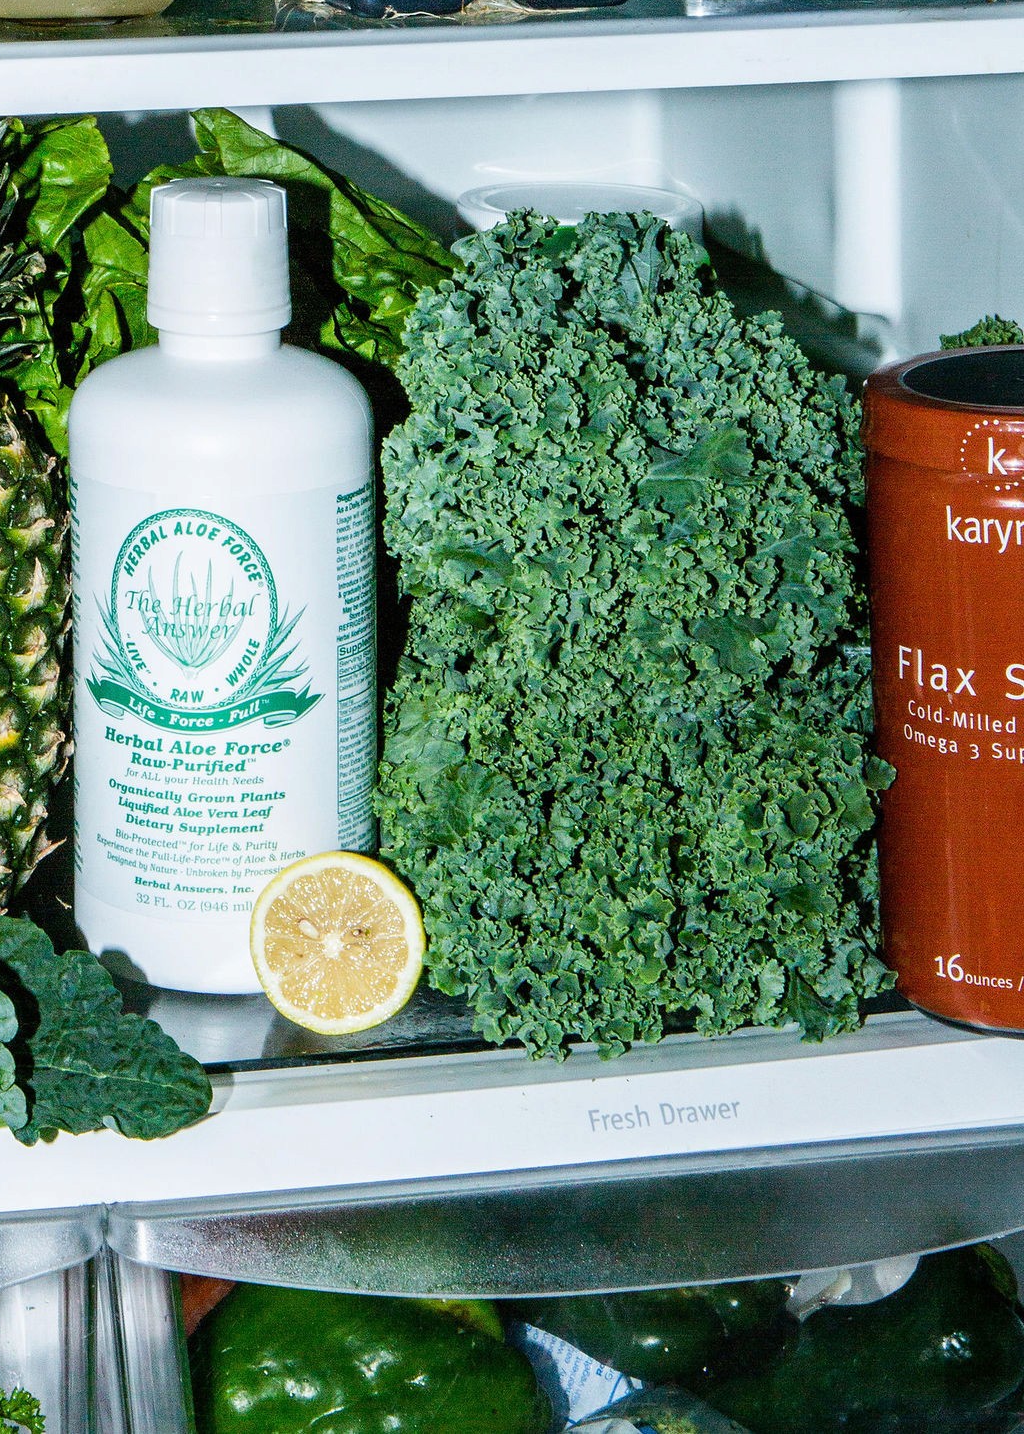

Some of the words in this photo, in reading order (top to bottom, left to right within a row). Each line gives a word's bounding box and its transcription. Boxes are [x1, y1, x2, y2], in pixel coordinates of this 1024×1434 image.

[124, 526, 168, 577] HERBAL
[174, 522, 221, 541] ALOE
[125, 590, 161, 614] The
[170, 592, 261, 617] Herbal
[141, 616, 235, 640] Answer
[170, 689, 204, 703] RAW
[225, 638, 260, 687] WHOLE
[899, 645, 976, 696] Flax
[128, 697, 156, 719] Life
[169, 713, 214, 728] Force
[908, 700, 1016, 734] Cold-Milled
[105, 726, 163, 752] Herbal
[169, 740, 216, 755] Aloe
[904, 724, 958, 754] Omega
[969, 744, 980, 760] 3
[125, 768, 139, 778] for
[140, 771, 161, 782] ALL
[164, 776, 188, 785] your
[192, 775, 229, 785] Health
[232, 775, 264, 785] Needs
[109, 778, 182, 804] Organically
[187, 792, 235, 803] Grown
[240, 790, 286, 803] Plants
[118, 796, 169, 816] Liquified
[173, 807, 203, 818] Aloe
[207, 808, 238, 818] Vera
[243, 805, 274, 819] Leaf
[125, 813, 173, 832] Dietary
[179, 822, 264, 836] Supplement
[96, 833, 133, 854] Experience
[135, 847, 149, 857] the
[232, 855, 242, 866] of
[244, 854, 266, 864] Aloe
[269, 853, 276, 862] &
[280, 849, 306, 861] Herbs
[188, 841, 204, 853] for
[208, 841, 229, 853] Life
[232, 842, 241, 851] &
[245, 840, 278, 852] Purity
[107, 851, 137, 868] Designed
[138, 860, 148, 872] by
[150, 863, 177, 875] Nature
[186, 867, 228, 877] Unbroken
[231, 868, 242, 879] by
[134, 876, 170, 891] Herbal
[232, 885, 255, 894] Inc.
[136, 892, 150, 905] 32
[154, 896, 172, 908] FL.
[177, 900, 196, 911] OZ
[200, 900, 229, 912] (946
[233, 900, 253, 912] ml)
[588, 1104, 650, 1132] Fresh
[659, 1100, 740, 1126] Drawer
